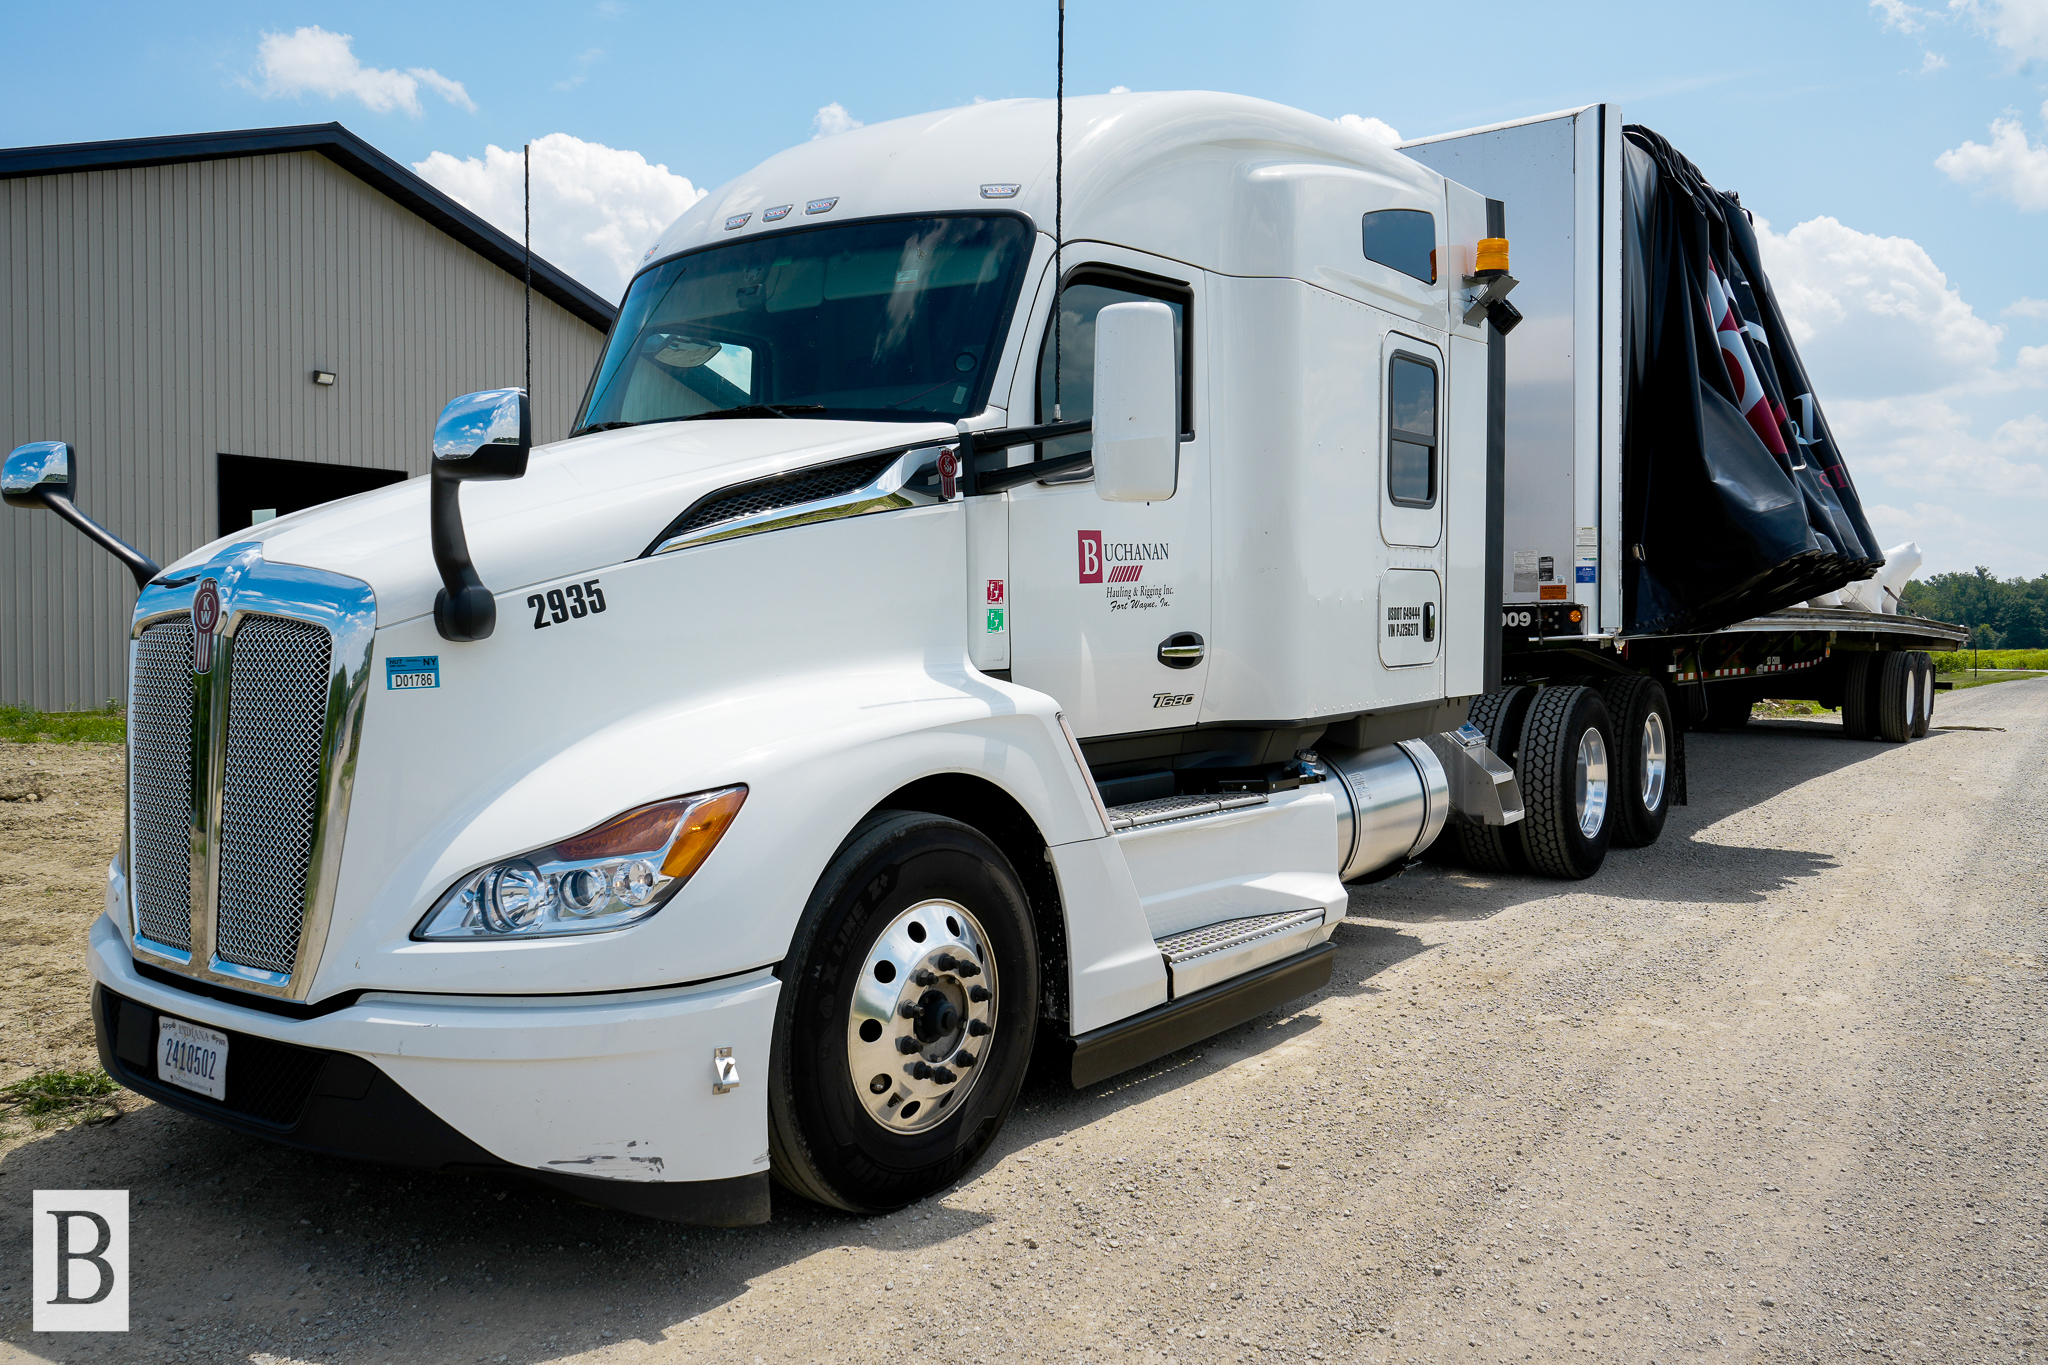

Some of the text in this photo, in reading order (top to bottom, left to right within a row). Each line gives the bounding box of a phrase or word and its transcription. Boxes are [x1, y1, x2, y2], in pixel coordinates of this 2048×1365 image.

[1081, 539, 1169, 575] BUCHANAN
[1106, 584, 1174, 600] Hauling & Rigging Inc.
[526, 579, 607, 630] 2935
[1109, 600, 1128, 612] Fort
[1387, 606, 1402, 620] USDOT
[1387, 623, 1396, 637] VIN
[422, 657, 437, 666] NY
[395, 673, 433, 688] D01786
[1152, 692, 1196, 709] T680
[178, 1024, 210, 1043] INDIANA
[165, 1037, 217, 1081] 2410502
[845, 1148, 964, 1193] MICHELIN
